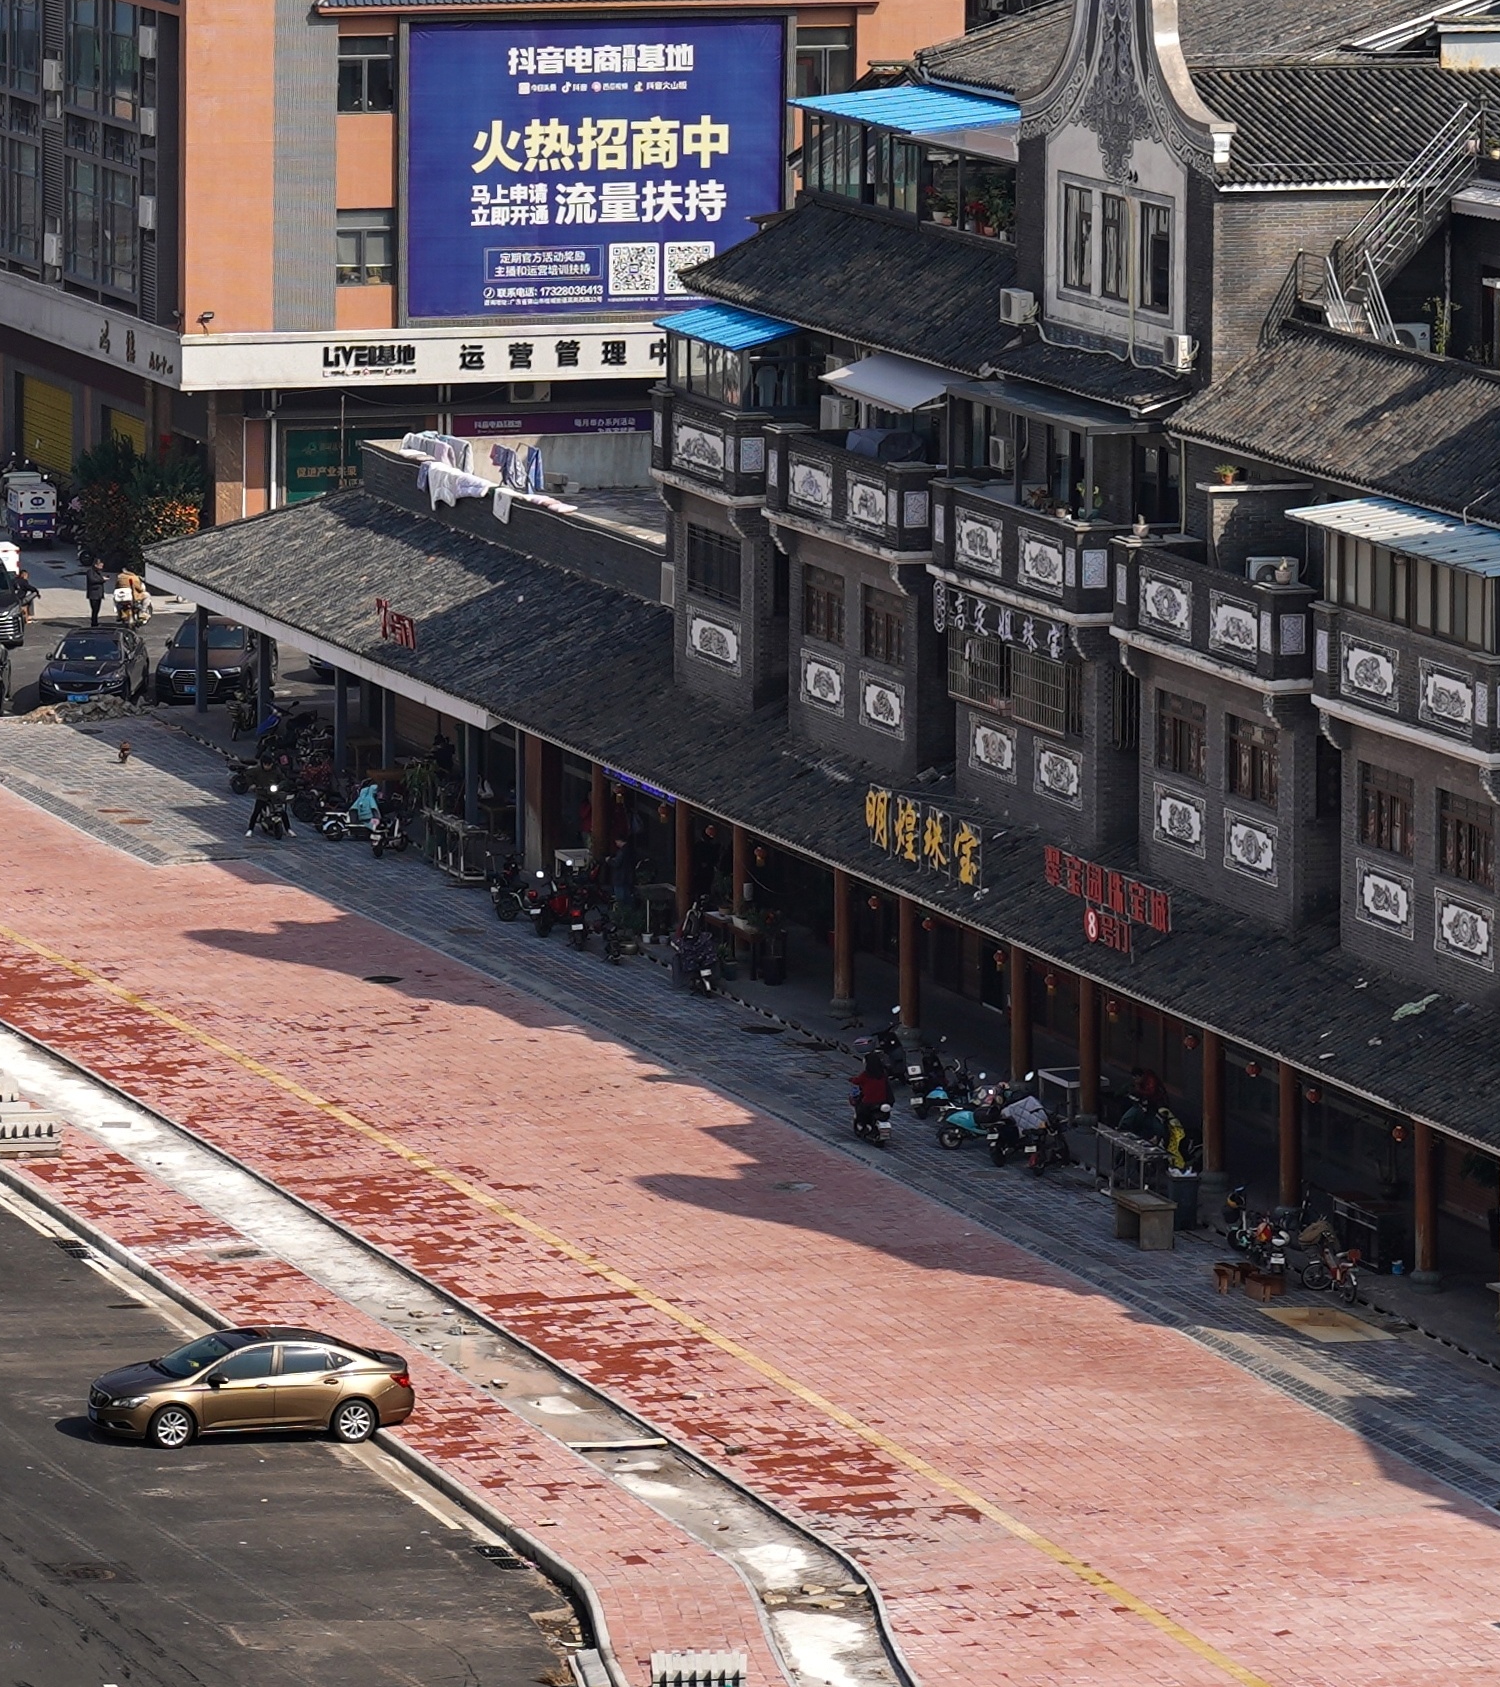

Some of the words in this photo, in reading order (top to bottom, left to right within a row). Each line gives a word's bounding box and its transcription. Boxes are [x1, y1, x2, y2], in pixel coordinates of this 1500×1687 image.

[471, 115, 729, 173] 火热招商中
[471, 183, 548, 205] 马上申请
[471, 205, 549, 227] 立即开通
[555, 179, 727, 224] 流量扶持
[1044, 845, 1170, 933] 翠宝园珠宝城
[1084, 907, 1131, 953] 8号门
